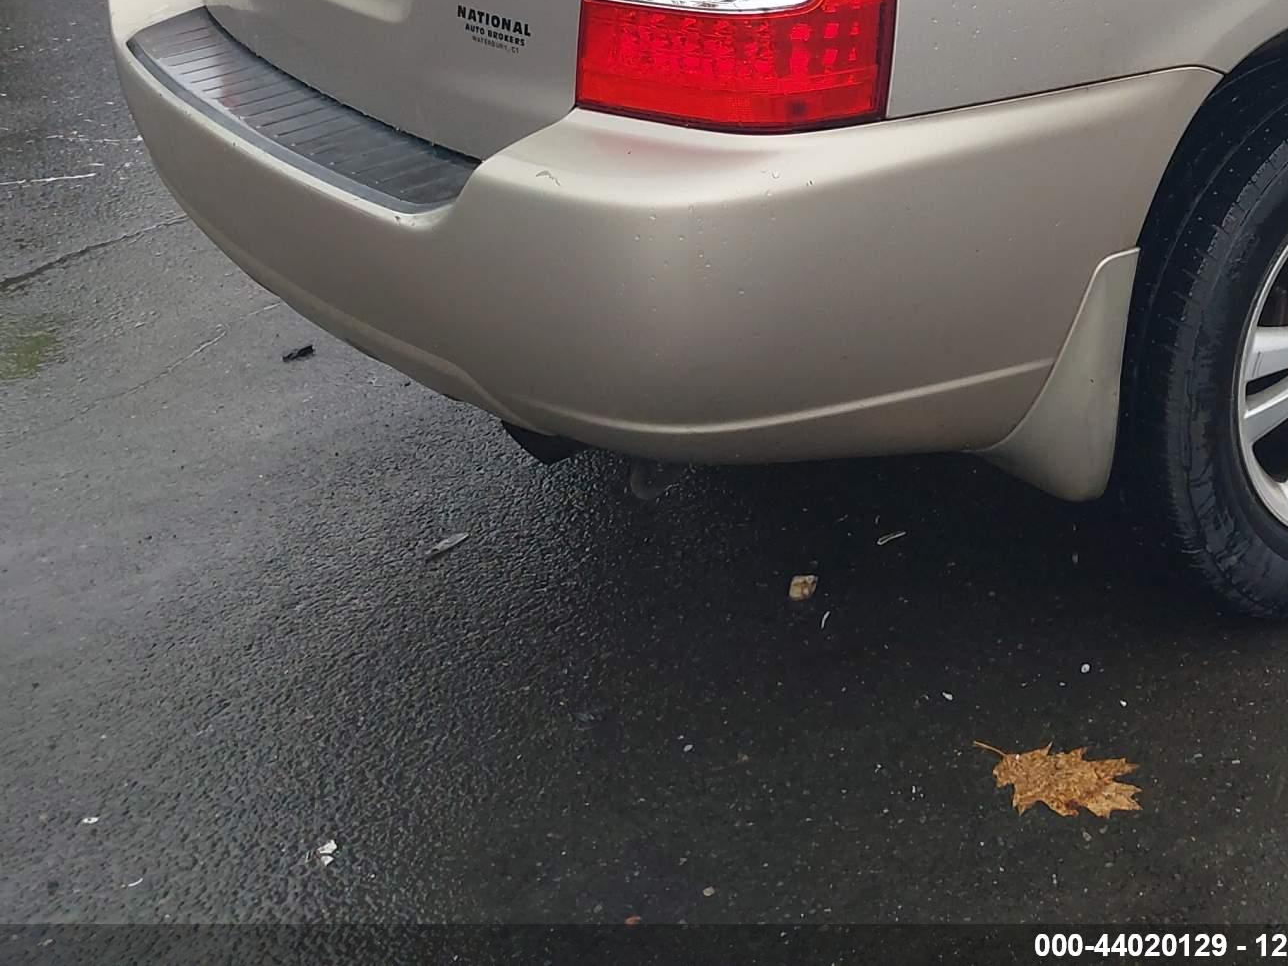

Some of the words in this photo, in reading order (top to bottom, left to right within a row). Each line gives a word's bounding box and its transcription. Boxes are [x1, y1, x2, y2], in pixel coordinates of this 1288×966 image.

[457, 4, 531, 37] NATIONAL
[465, 23, 485, 35] AUTO
[487, 29, 525, 47] BROKERS
